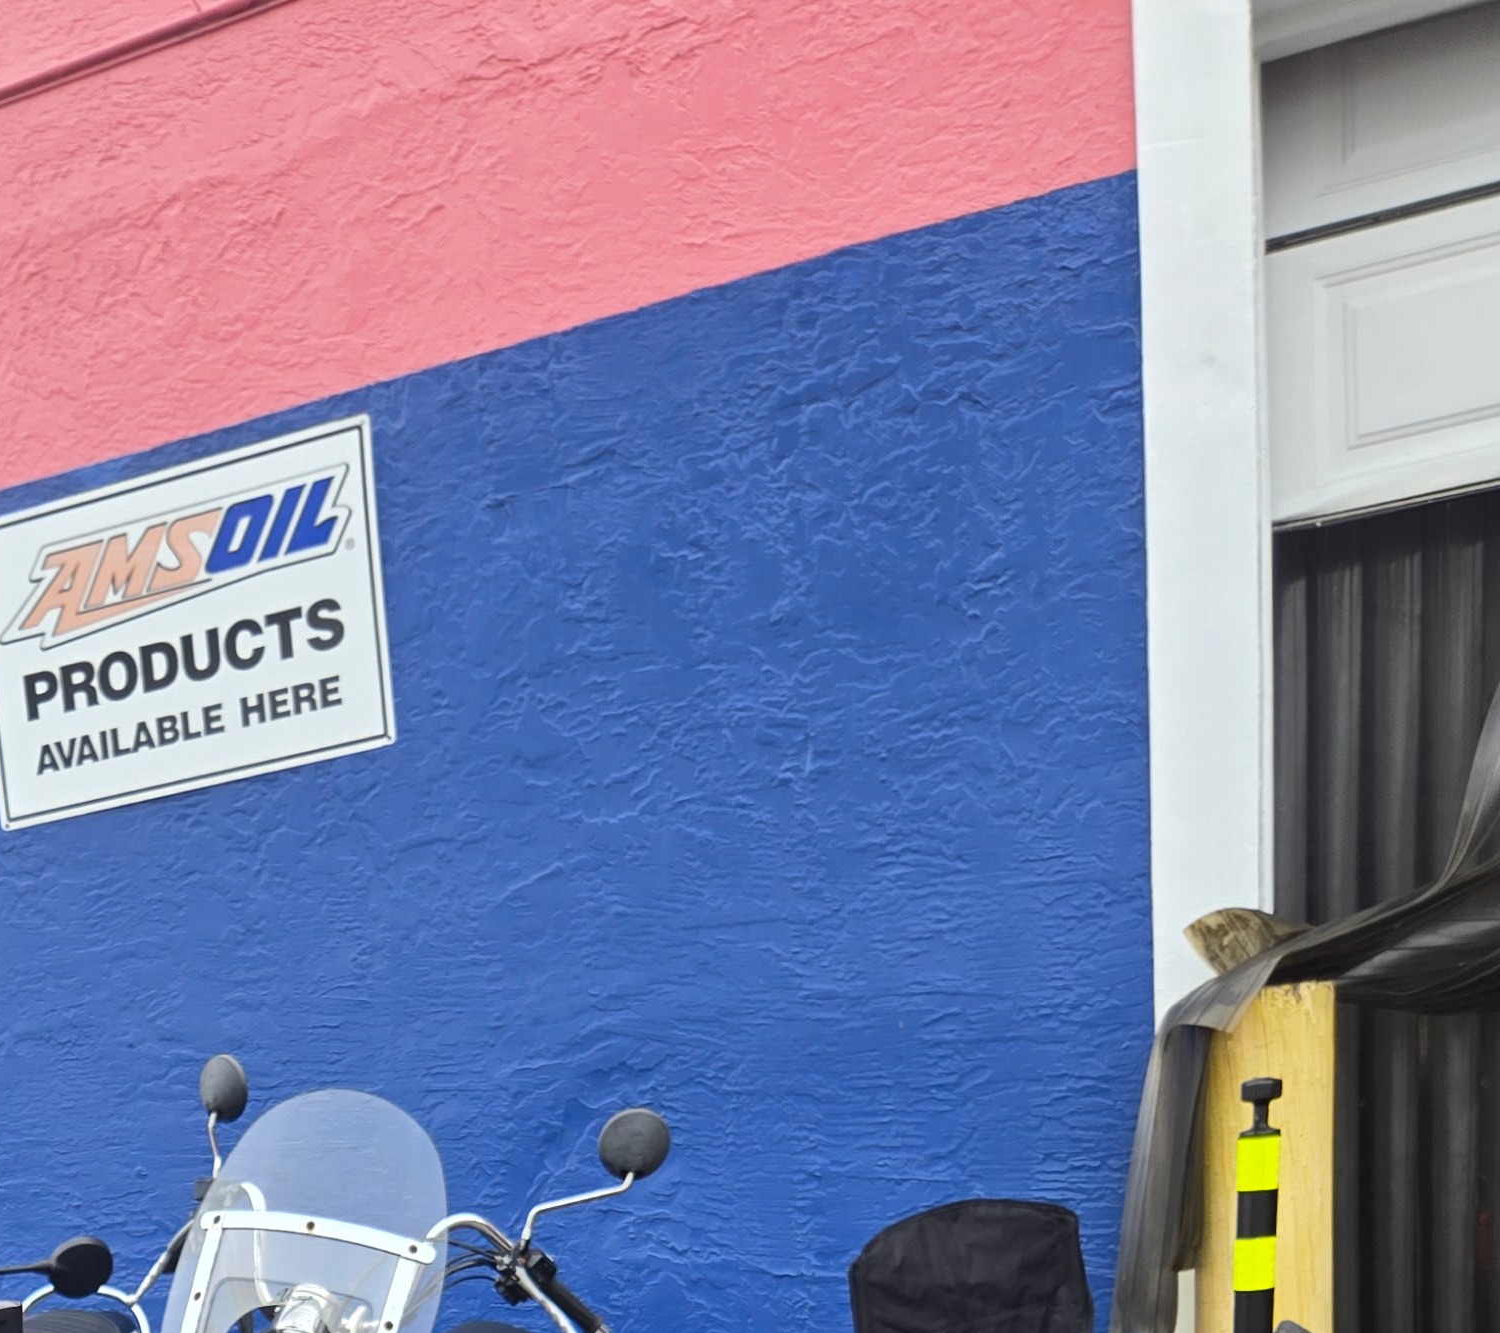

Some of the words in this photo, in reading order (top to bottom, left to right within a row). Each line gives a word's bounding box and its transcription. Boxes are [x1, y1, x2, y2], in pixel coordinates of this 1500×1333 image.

[18, 476, 339, 637] AMSOIL
[23, 598, 345, 721] PRODUCTS
[37, 703, 226, 776] AVAILABLE
[240, 675, 343, 727] HERE
